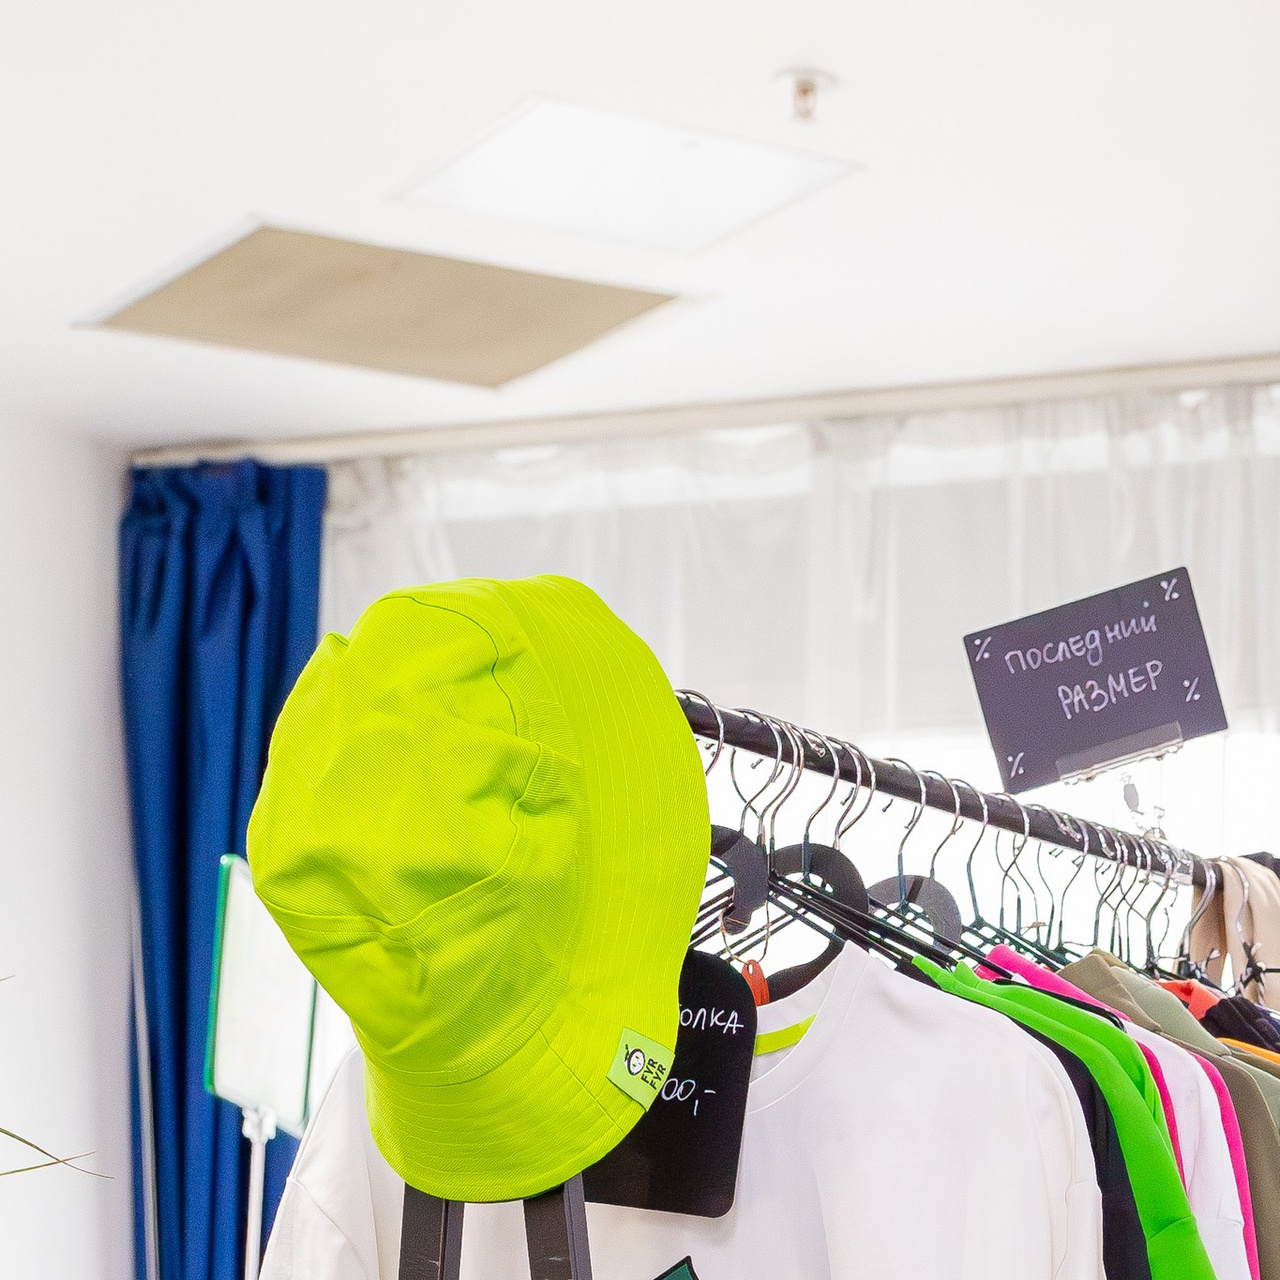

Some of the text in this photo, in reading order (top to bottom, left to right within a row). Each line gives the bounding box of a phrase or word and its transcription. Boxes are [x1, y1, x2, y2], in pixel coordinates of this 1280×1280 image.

[1057, 660, 1163, 720] РАЗМЕР
[679, 1004, 745, 1035] ОЛКА
[641, 1058, 658, 1083] FYR
[649, 1064, 666, 1090] FYR
